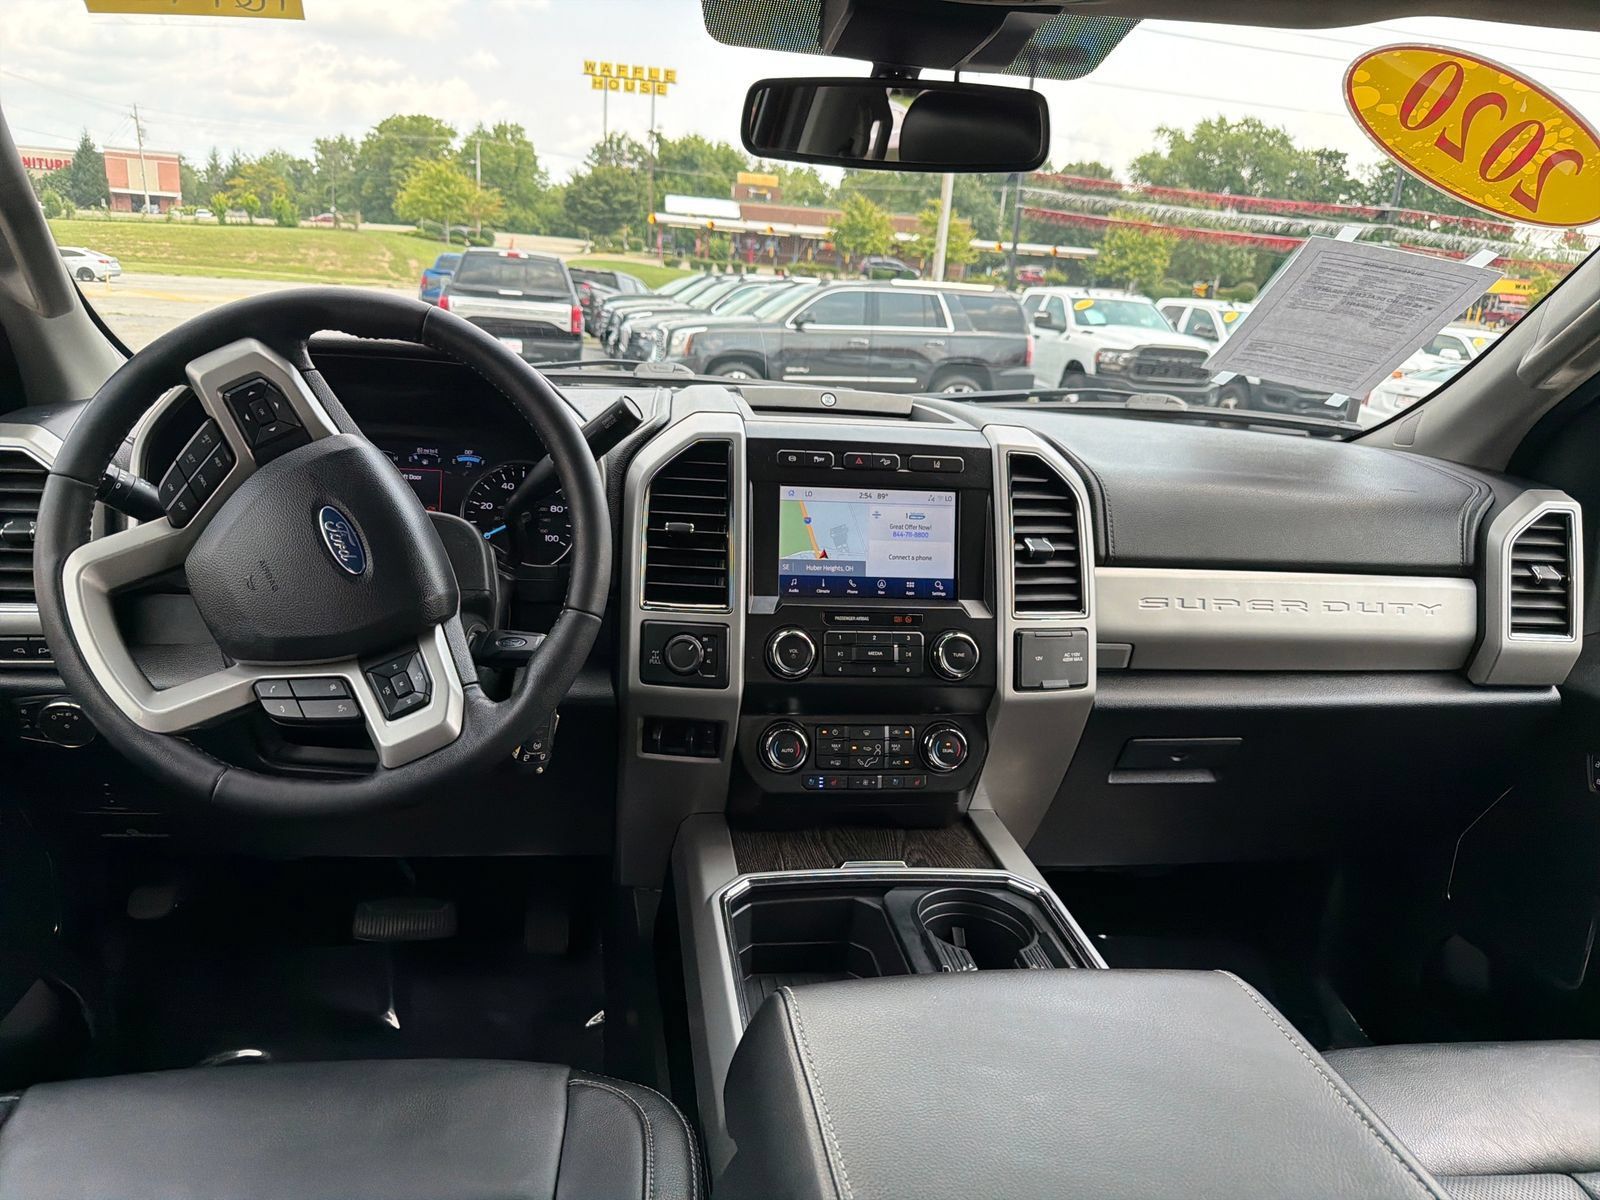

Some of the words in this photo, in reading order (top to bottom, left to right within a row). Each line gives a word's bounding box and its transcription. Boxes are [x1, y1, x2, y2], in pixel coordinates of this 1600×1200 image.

[584, 60, 677, 82] WAFFLE
[592, 76, 668, 95] HOUSE
[501, 482, 515, 490] 40
[480, 502, 493, 510] 20
[550, 505, 563, 513] 80
[324, 521, 358, 562] Ford
[888, 553, 911, 561] Connect
[915, 554, 932, 562] phone
[823, 565, 844, 573] Heights,
[1139, 596, 1309, 613] SUPER
[1322, 600, 1443, 615] DUTY
